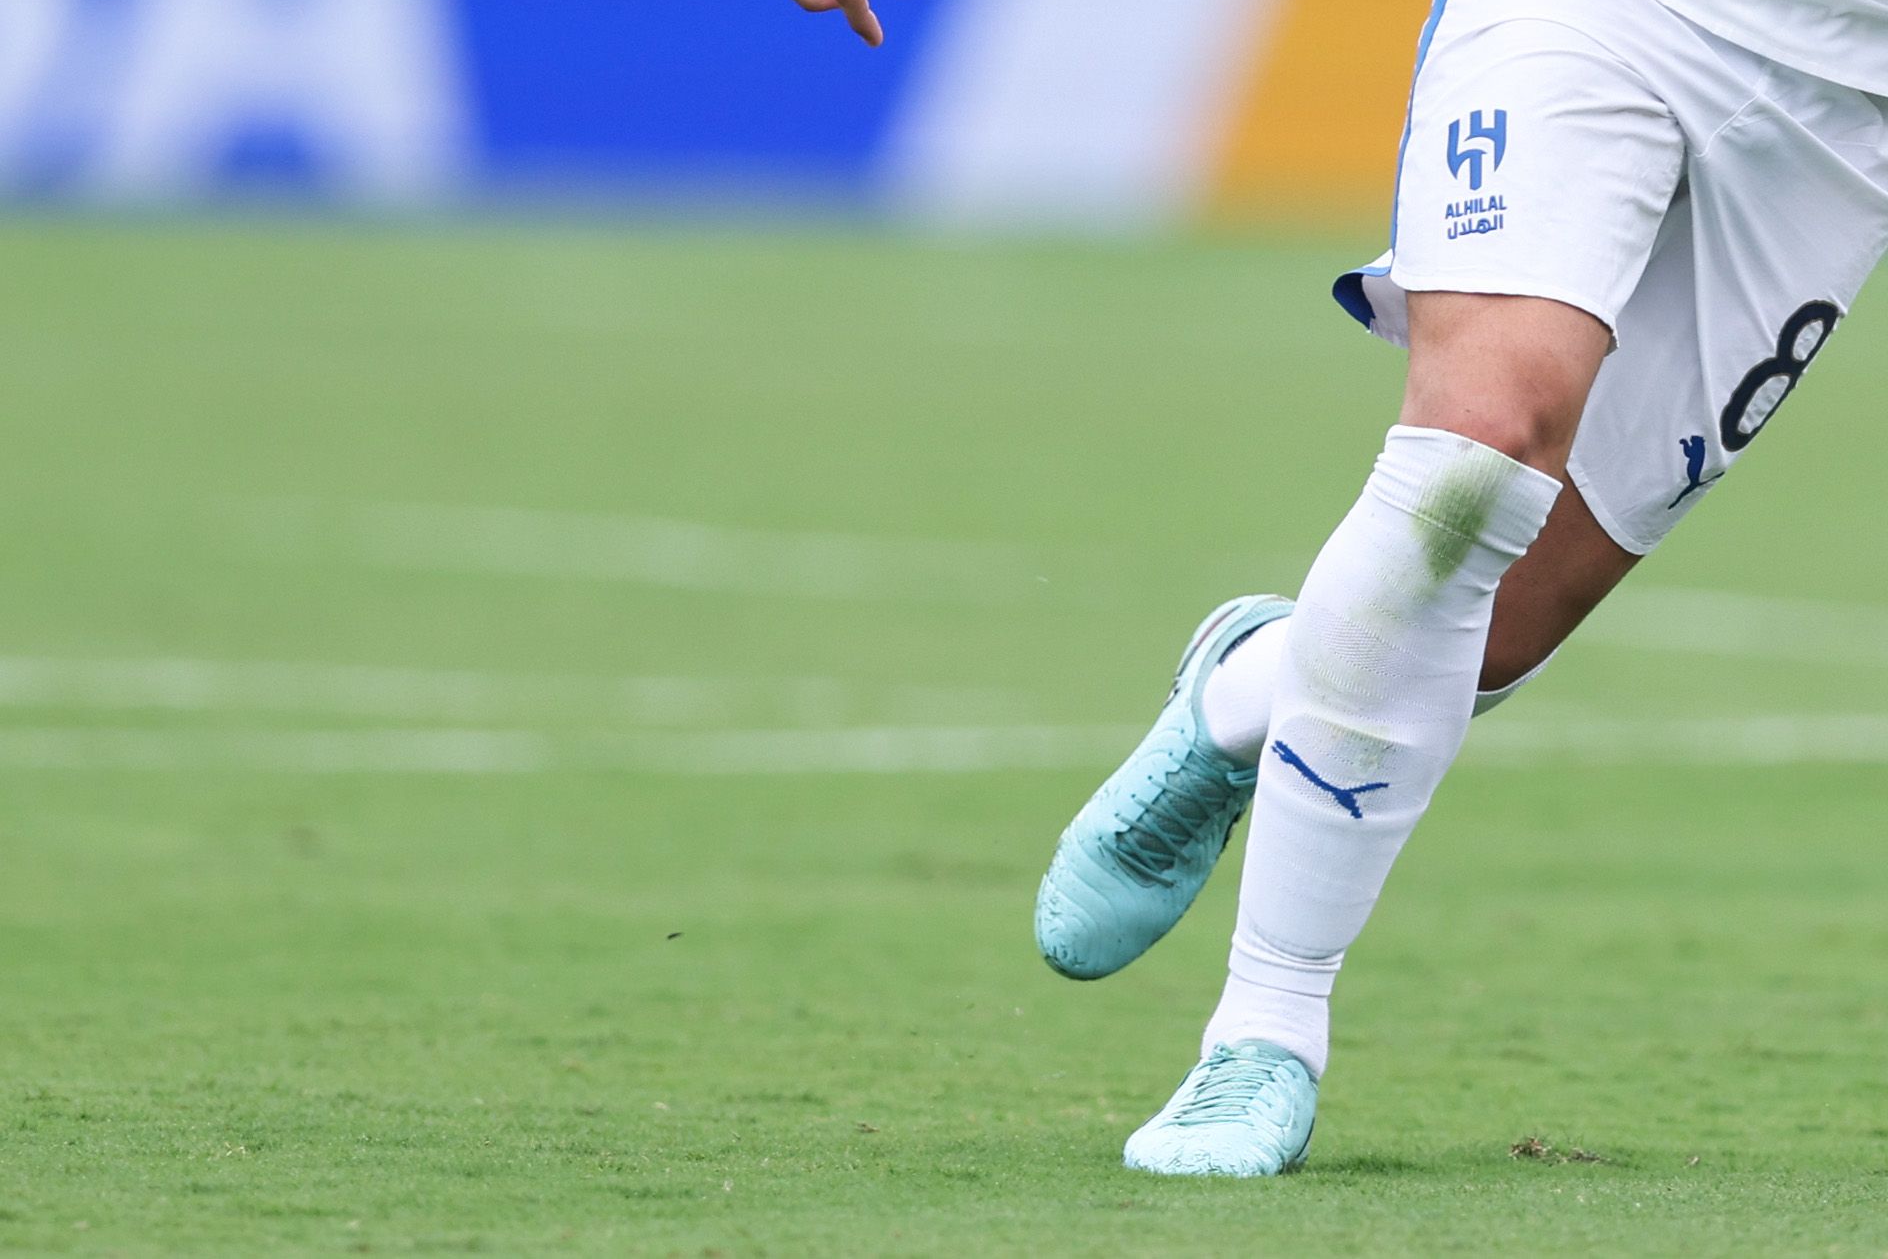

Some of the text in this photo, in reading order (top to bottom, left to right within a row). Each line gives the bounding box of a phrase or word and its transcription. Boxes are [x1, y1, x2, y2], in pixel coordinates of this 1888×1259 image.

[1445, 195, 1507, 219] ALHILAL
[1447, 214, 1503, 239] الهلال
[1720, 300, 1839, 452] 8
